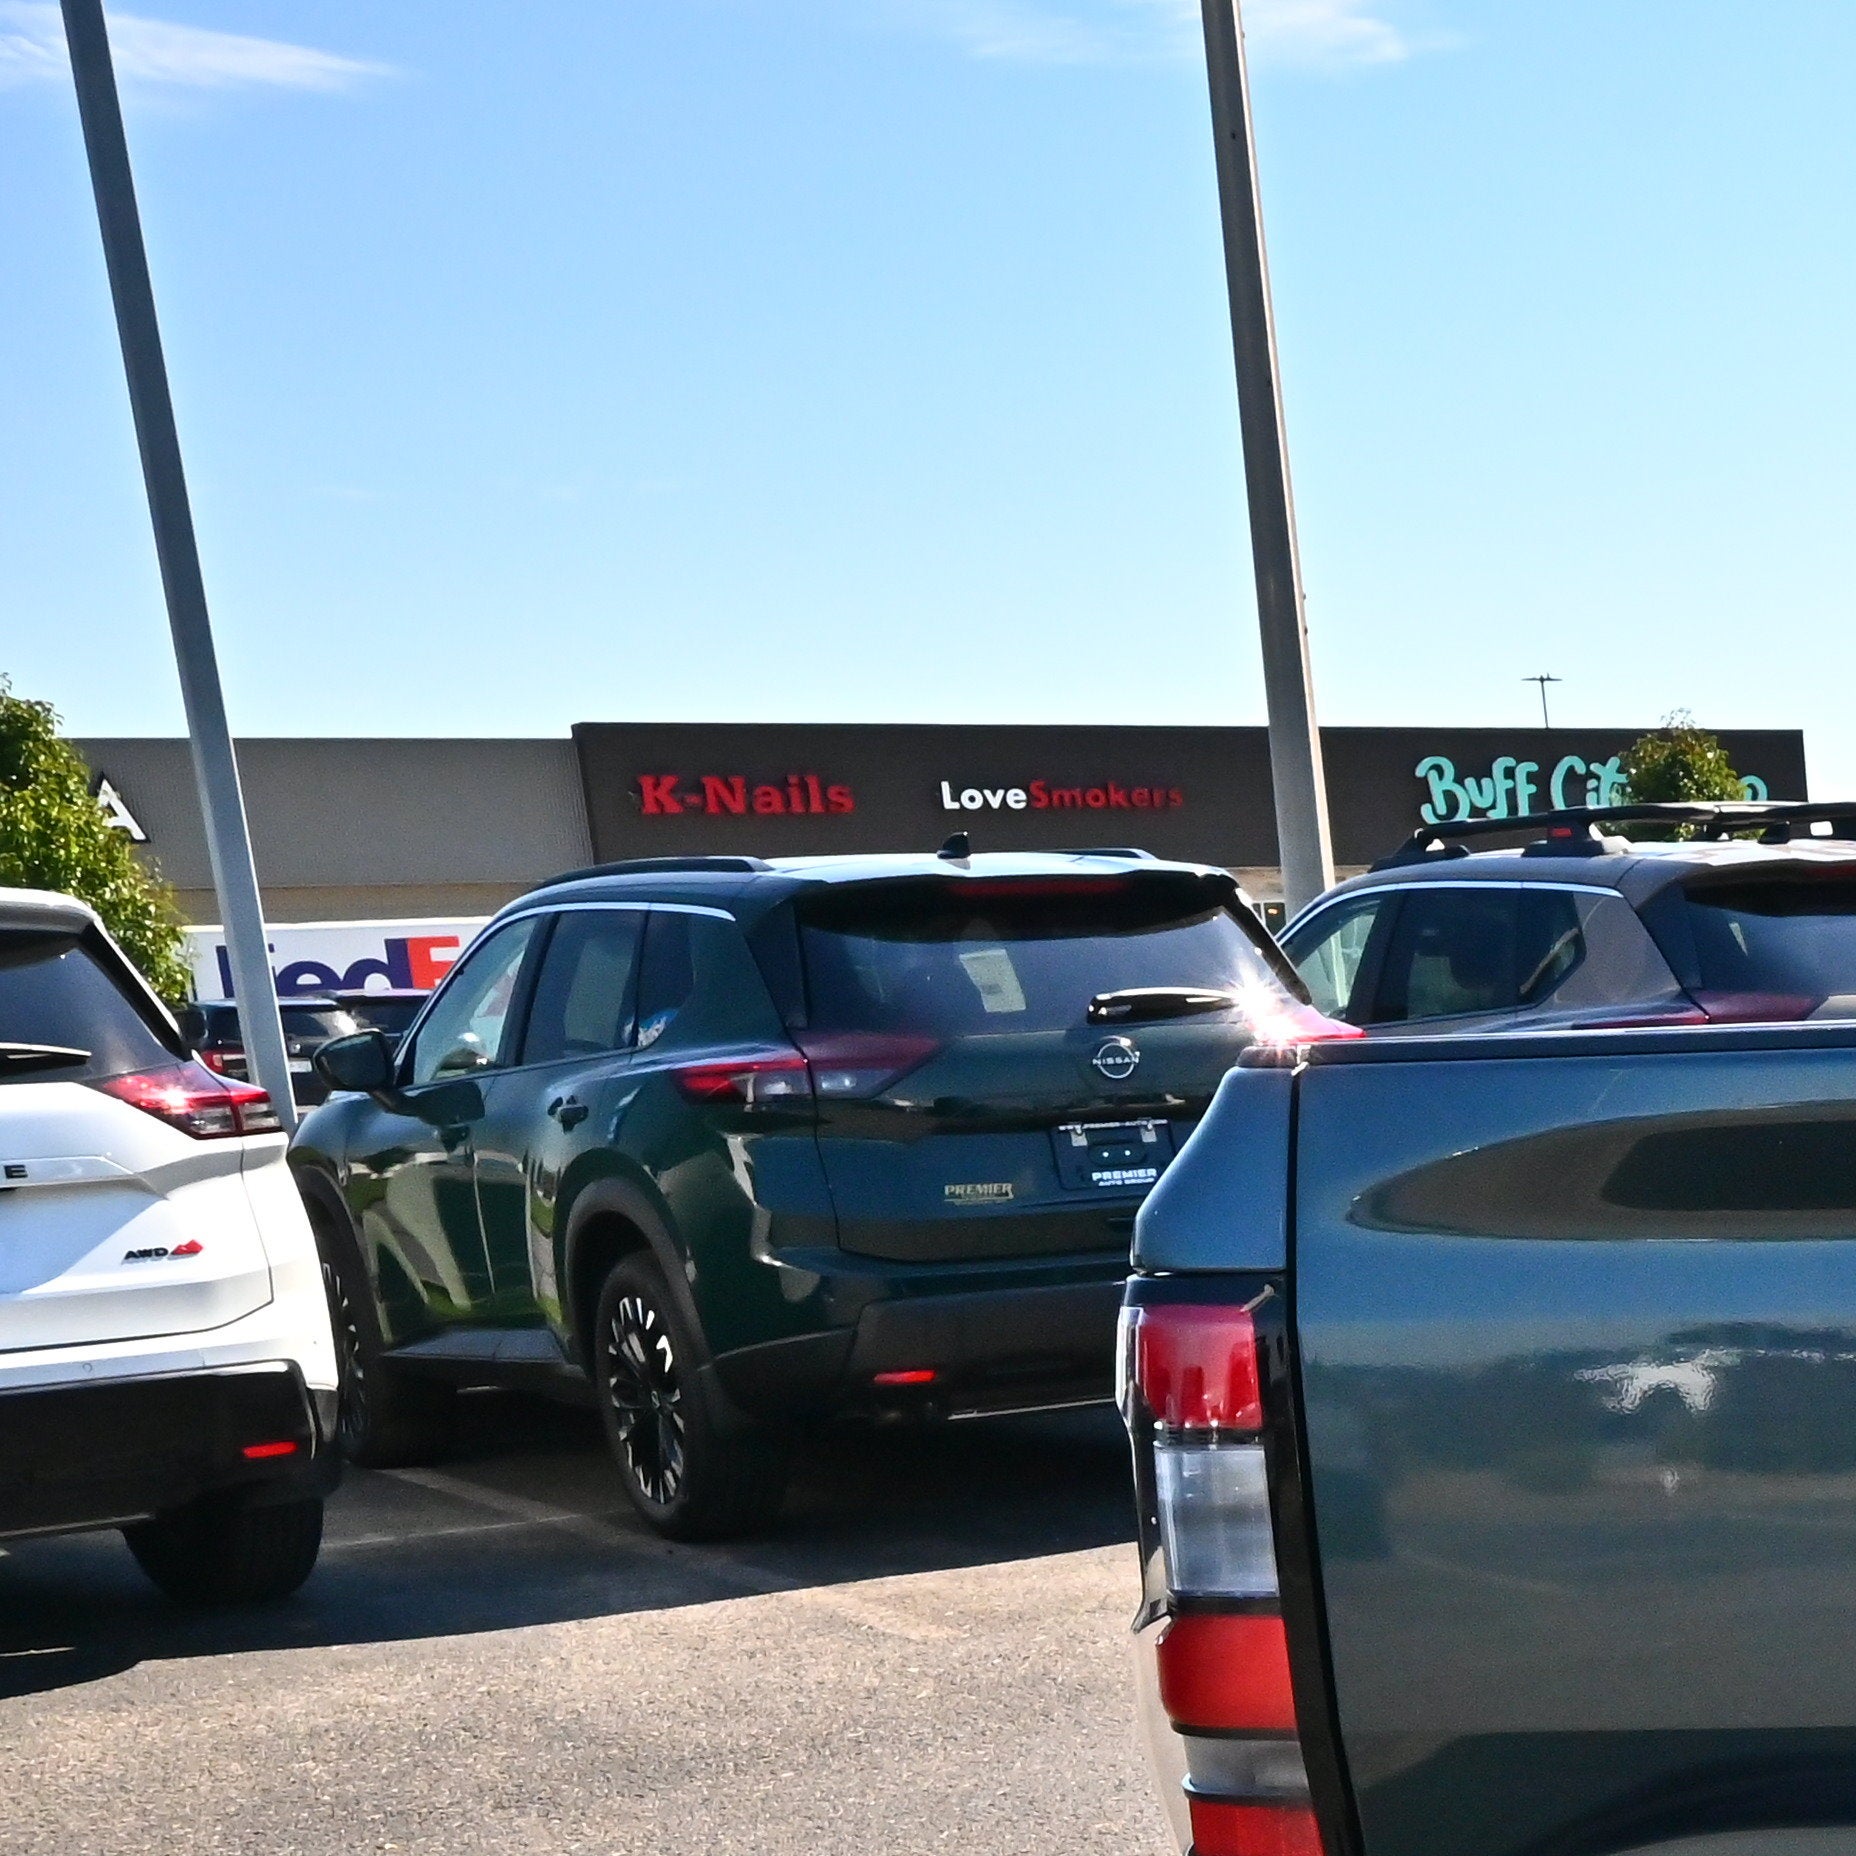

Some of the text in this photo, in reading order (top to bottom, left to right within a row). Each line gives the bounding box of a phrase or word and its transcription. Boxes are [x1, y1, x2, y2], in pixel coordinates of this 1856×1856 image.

[638, 773, 857, 815] K-Nails
[1415, 755, 1632, 825] Buff Cit
[1092, 1053, 1140, 1066] NISSAN
[1091, 1168, 1158, 1182] PREMIER
[944, 1182, 1014, 1199] PREMIER
[123, 1247, 169, 1261] AWD
